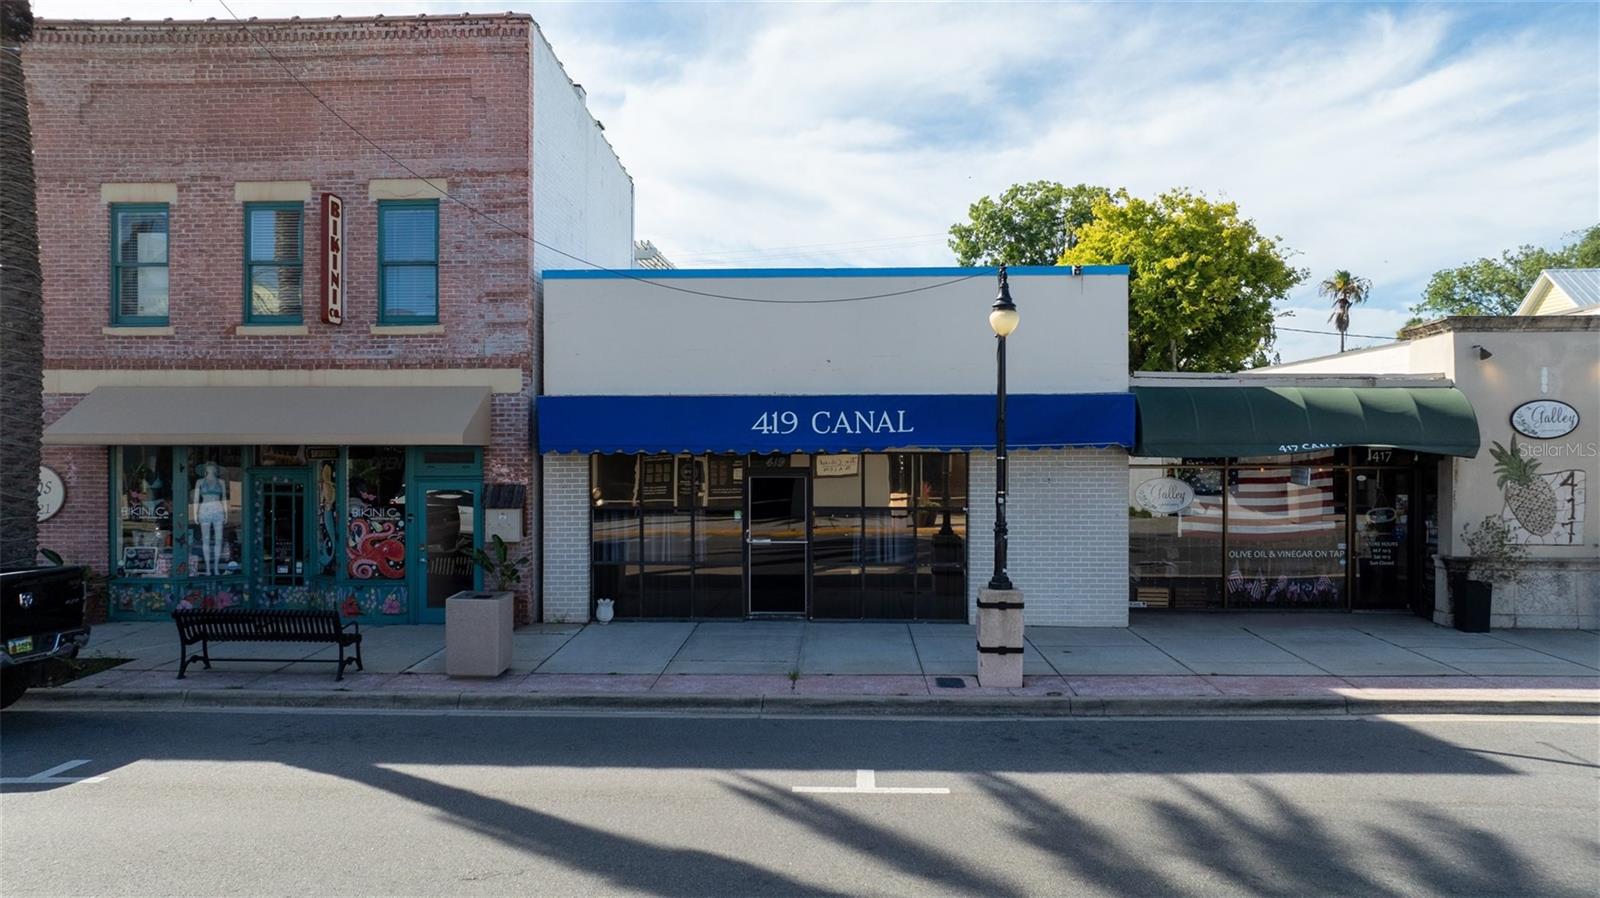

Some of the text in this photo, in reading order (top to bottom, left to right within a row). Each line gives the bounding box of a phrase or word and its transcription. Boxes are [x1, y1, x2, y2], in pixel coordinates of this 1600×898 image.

[331, 201, 340, 304] BIKINI
[751, 410, 915, 434] 419 CANAL
[1531, 405, 1576, 428] Galley
[1279, 444, 1298, 453] 417
[1372, 451, 1392, 463] 417
[1228, 550, 1345, 559] OLIVE OIL & VINEGAR ON TAP
